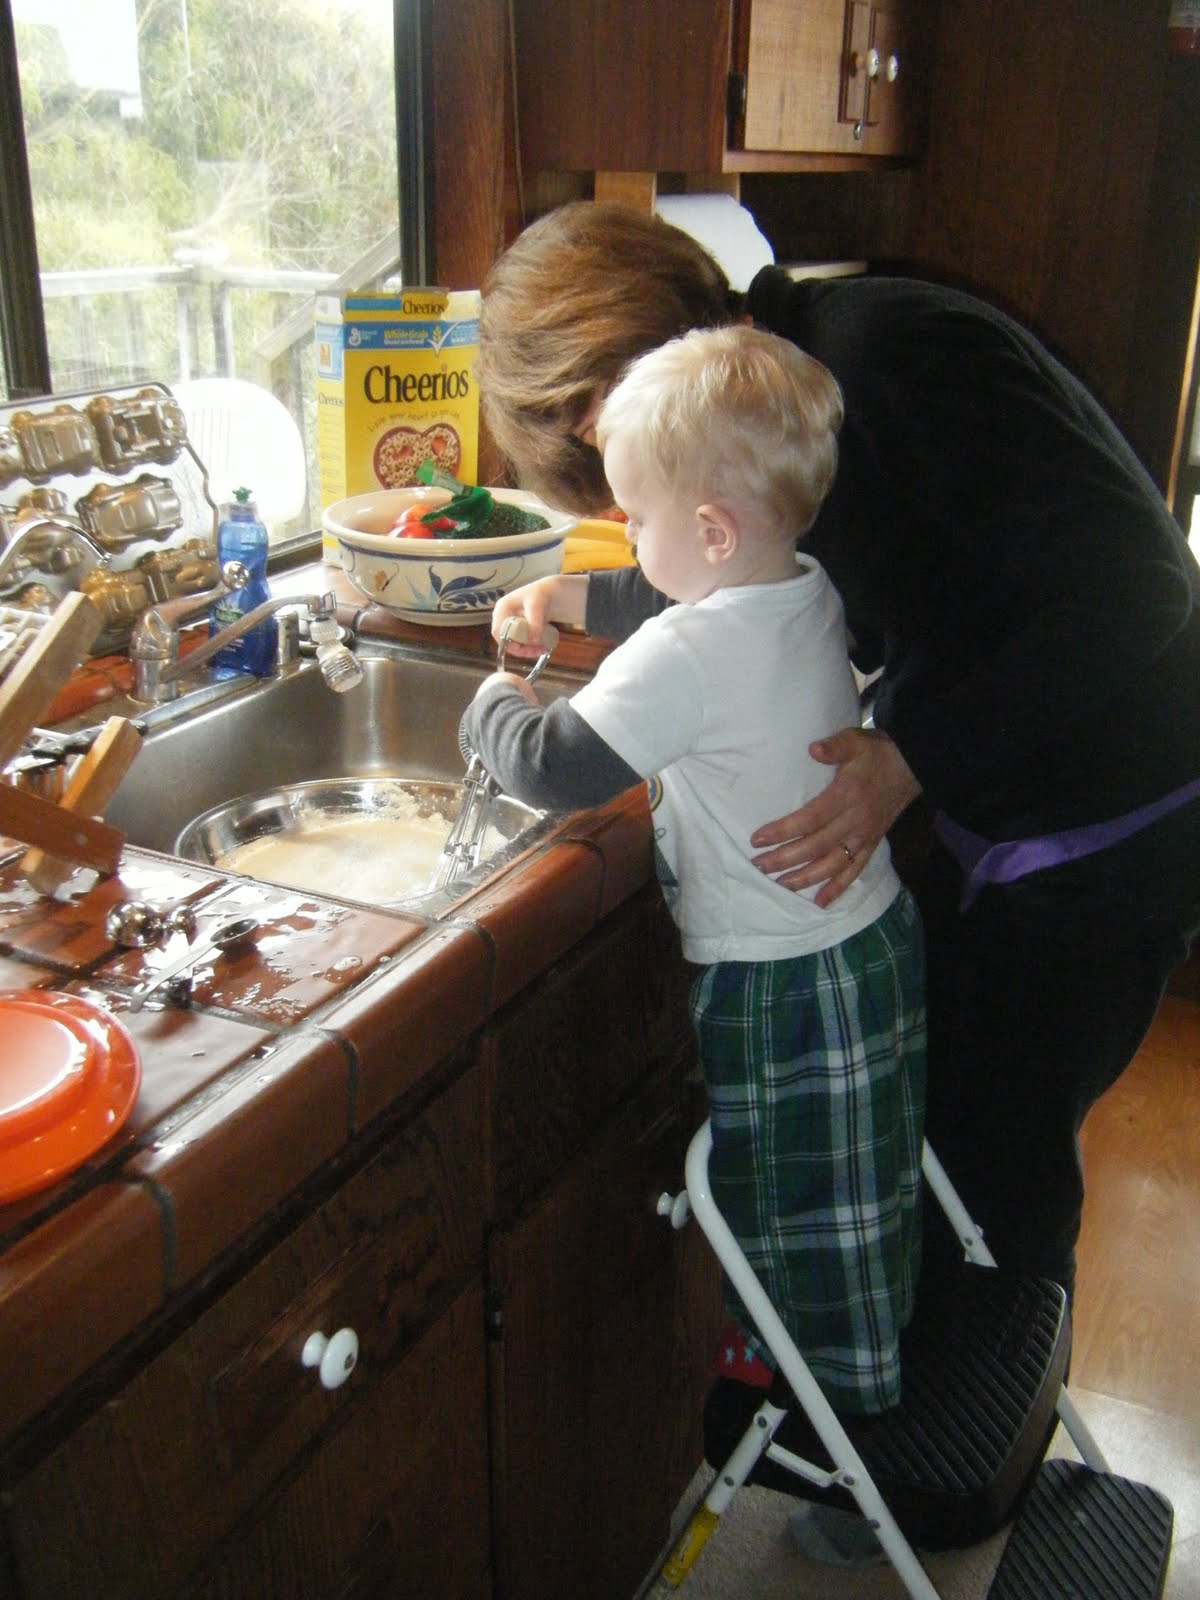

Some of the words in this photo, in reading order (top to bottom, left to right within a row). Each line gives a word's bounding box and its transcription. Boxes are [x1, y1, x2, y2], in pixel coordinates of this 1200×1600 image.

[402, 300, 446, 315] Cheerios
[364, 364, 469, 404] Cheerios
[318, 392, 344, 408] Cheerios
